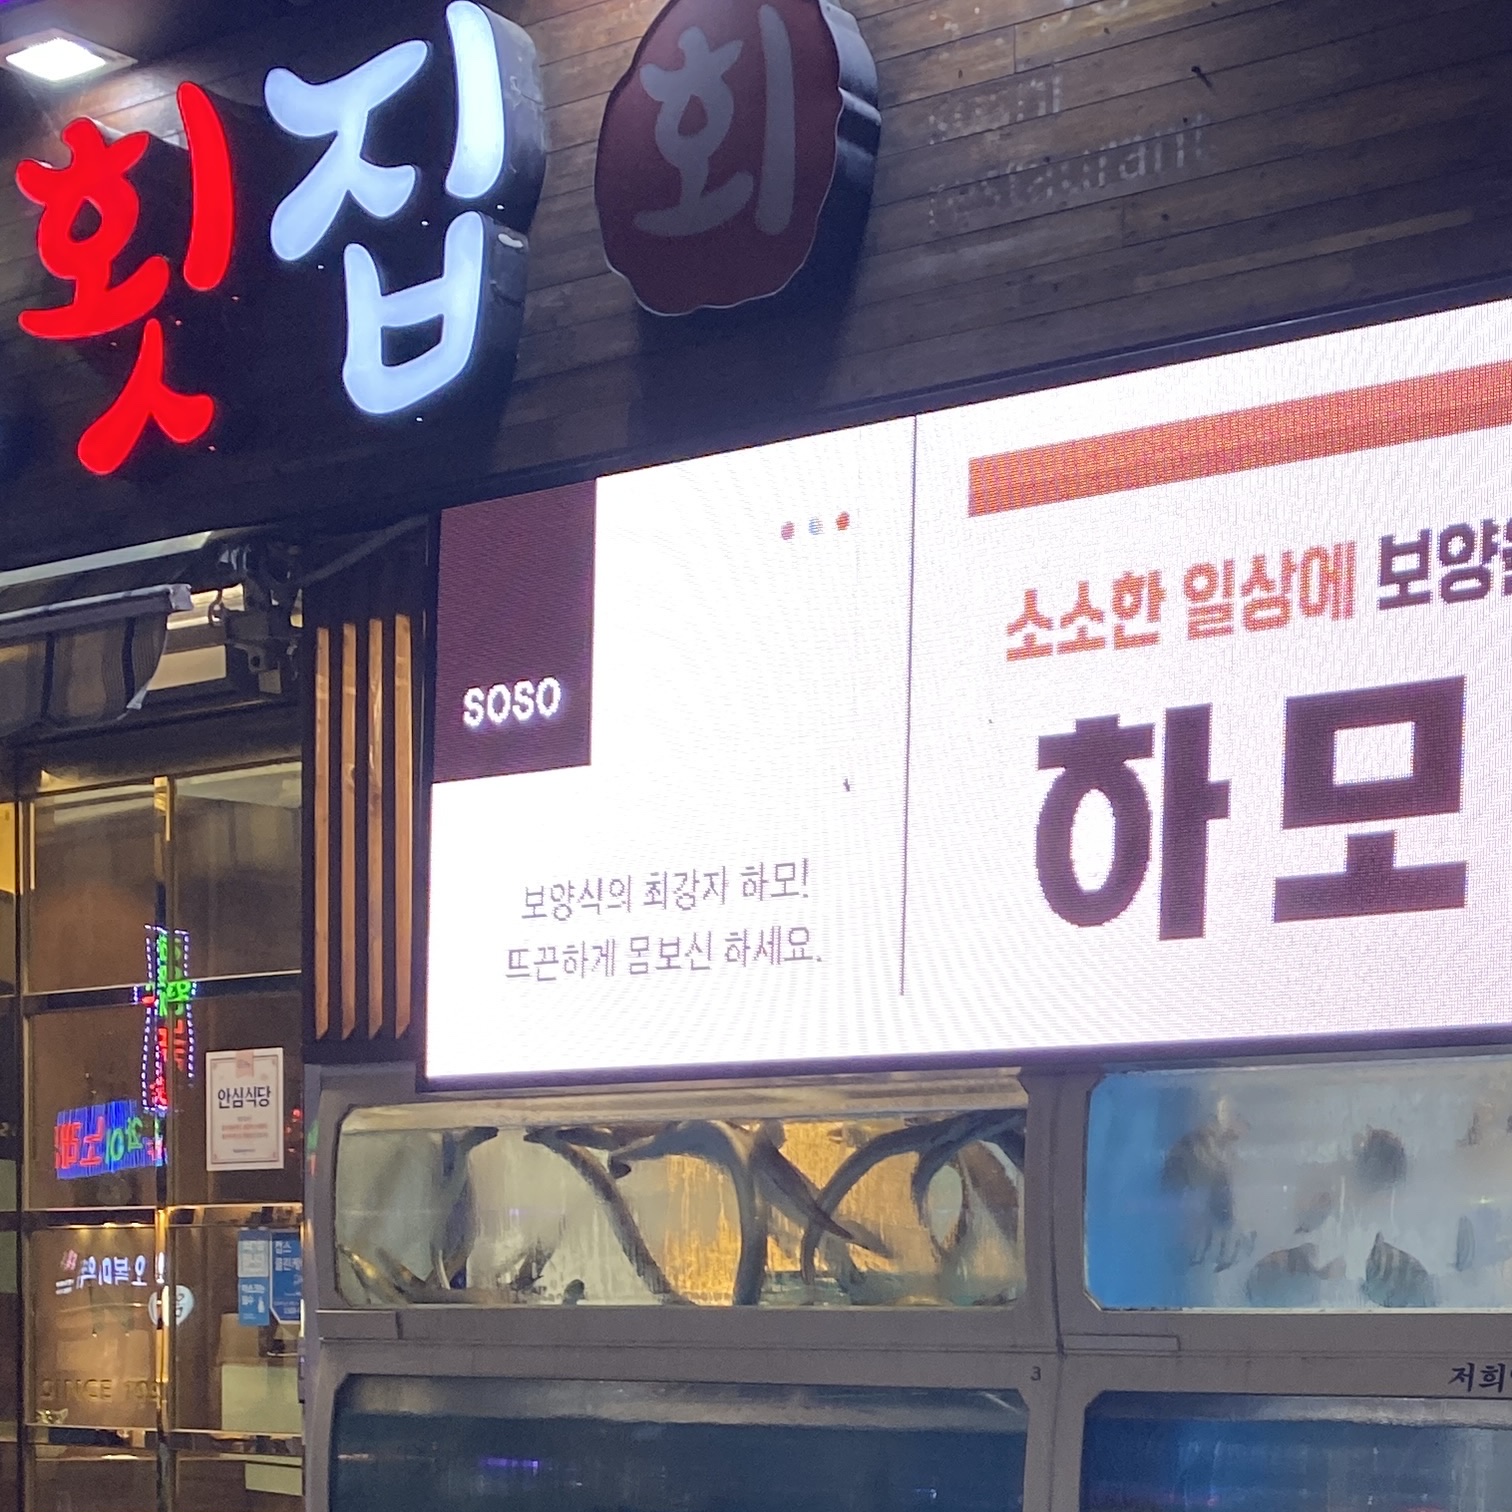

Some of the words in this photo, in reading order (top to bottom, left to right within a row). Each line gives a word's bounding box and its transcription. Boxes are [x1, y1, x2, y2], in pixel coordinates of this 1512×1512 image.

[633, 2, 797, 238] 회
[14, 0, 508, 476] 횟집
[1005, 570, 1166, 662] 소소한
[1183, 538, 1358, 641] 일상에
[462, 676, 563, 728] SOSO
[521, 873, 632, 921] 보양식의
[739, 857, 810, 902] 하모!
[505, 937, 616, 982] 뜨끈하게
[628, 930, 713, 975] 몸보신
[724, 924, 823, 968] 하세요.
[217, 1085, 272, 1110] 안심식당
